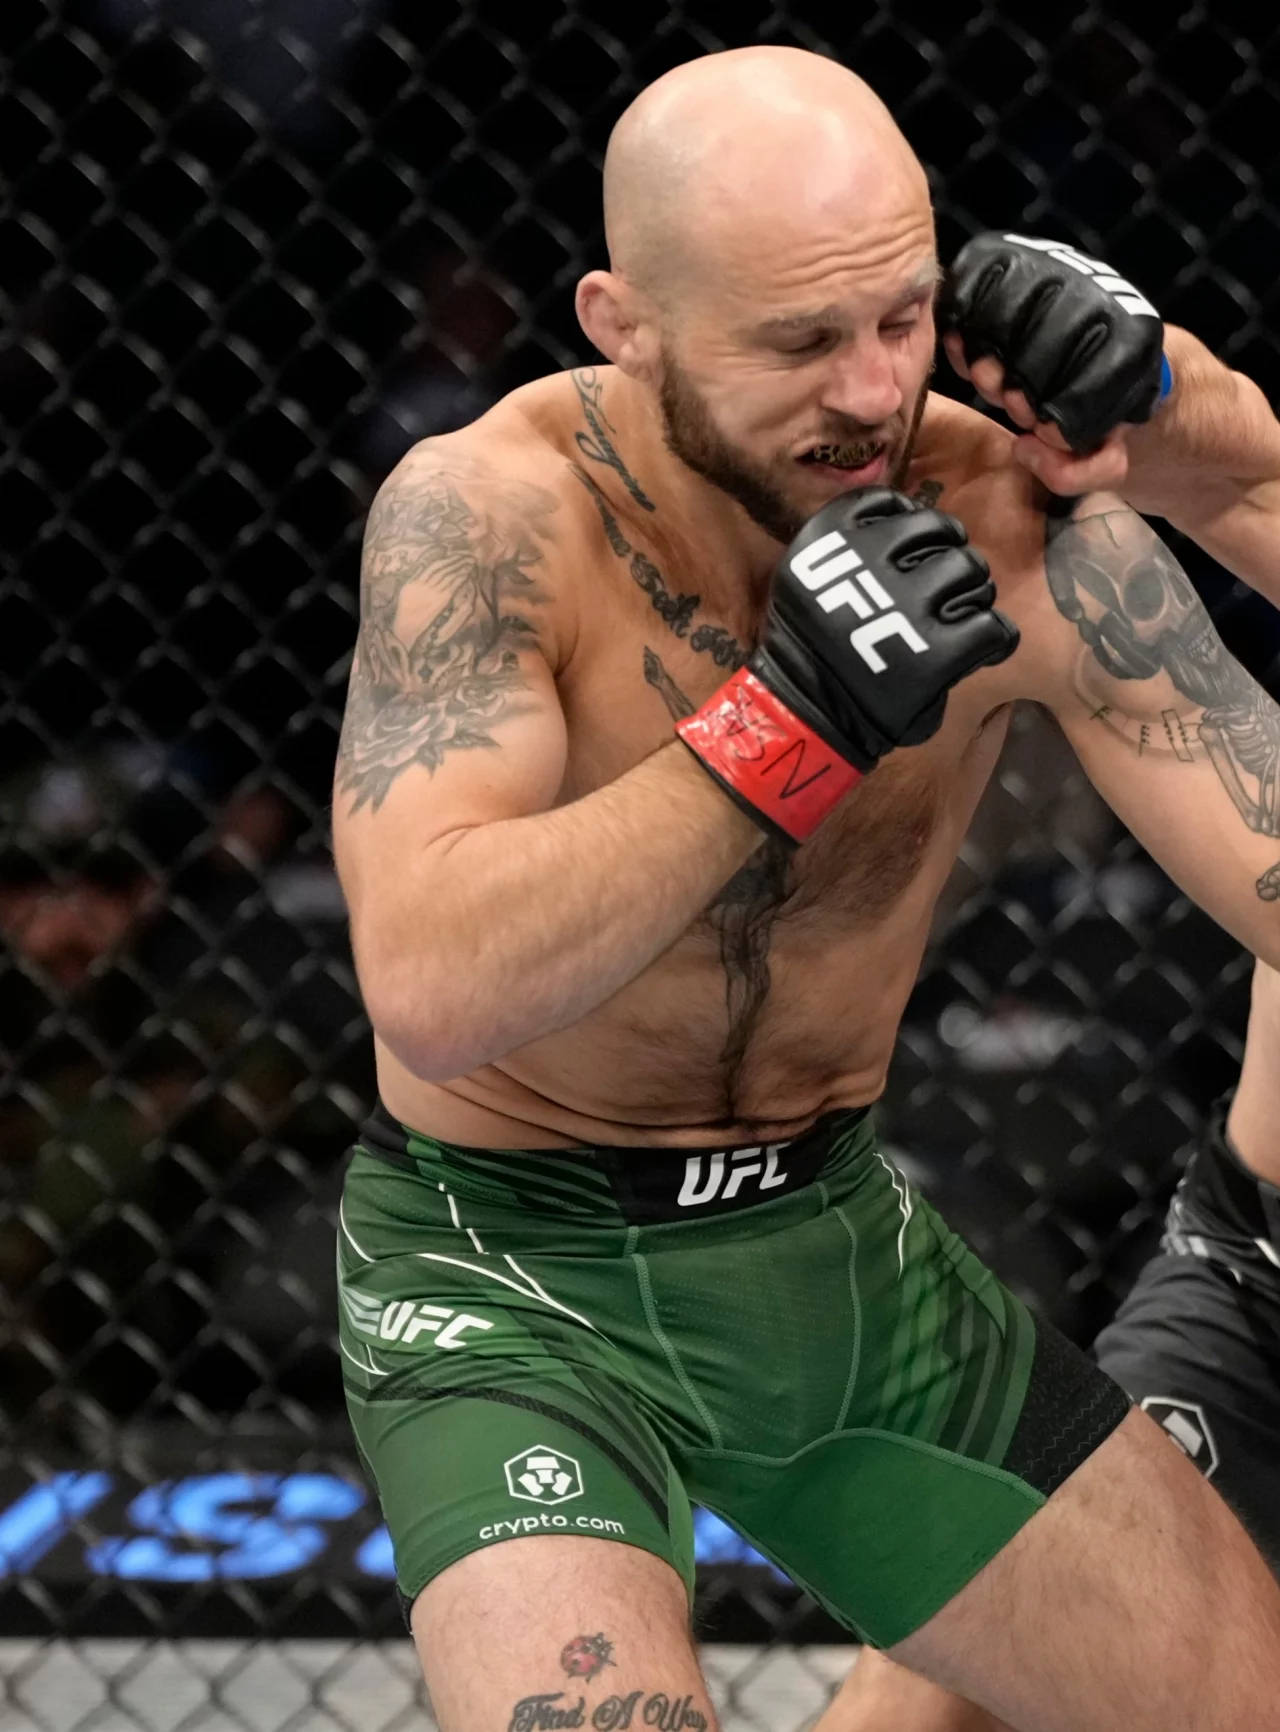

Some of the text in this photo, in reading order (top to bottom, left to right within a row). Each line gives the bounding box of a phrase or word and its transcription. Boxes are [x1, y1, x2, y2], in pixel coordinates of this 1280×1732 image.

[790, 530, 930, 675] UFC
[676, 1142, 795, 1208] UFC
[379, 1300, 495, 1350] UFC
[478, 1512, 625, 1541] crypto.com
